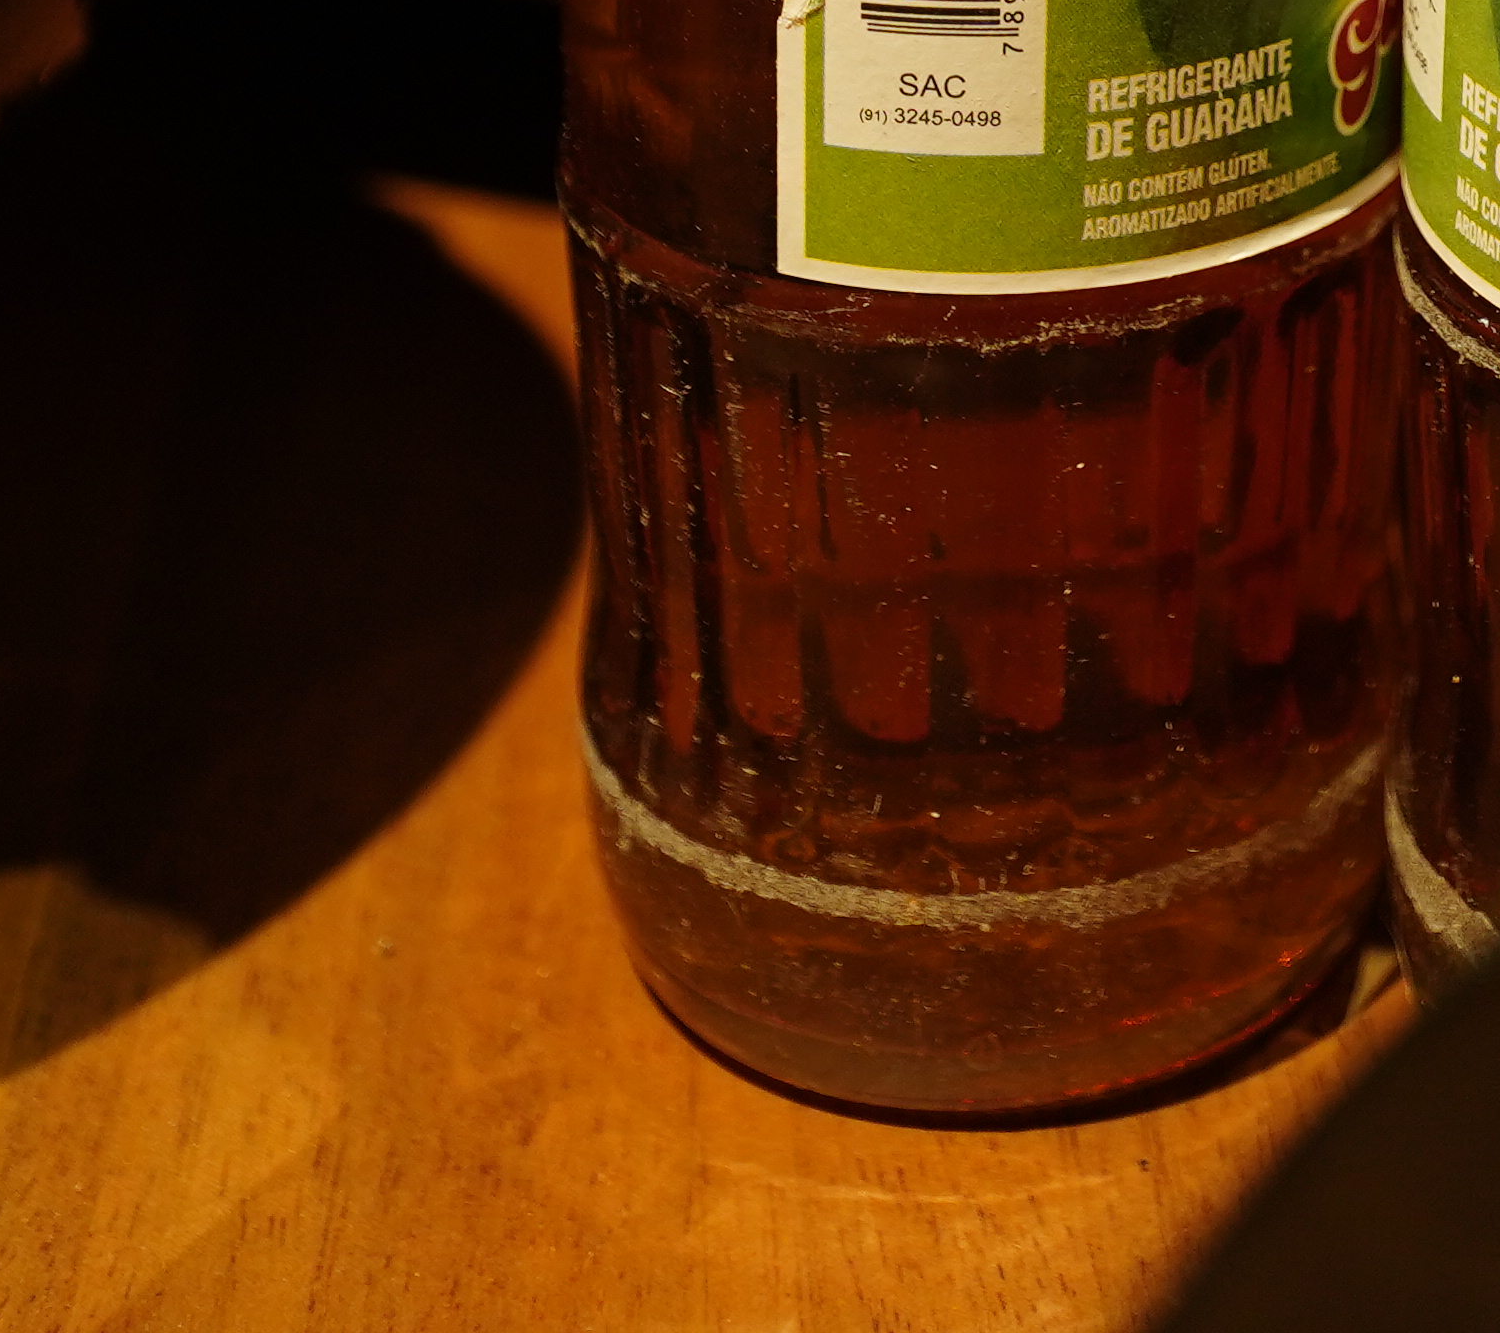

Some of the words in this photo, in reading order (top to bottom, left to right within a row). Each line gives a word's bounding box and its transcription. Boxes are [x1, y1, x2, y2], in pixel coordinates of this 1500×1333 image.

[898, 72, 967, 99] SAC
[1087, 38, 1293, 115] REFRIGERANTE
[858, 107, 888, 125] (91)
[894, 107, 1002, 127] 3245-0498
[1085, 117, 1135, 162] DE
[1145, 70, 1294, 154] GUARANÁ
[1458, 114, 1489, 171] DE
[1082, 179, 1123, 209] NÃO
[1127, 164, 1204, 203] CONTÉM
[1207, 147, 1273, 187] GLÚTEN.
[1456, 174, 1479, 211] NÃO
[1080, 198, 1212, 242] AROMATIZADO
